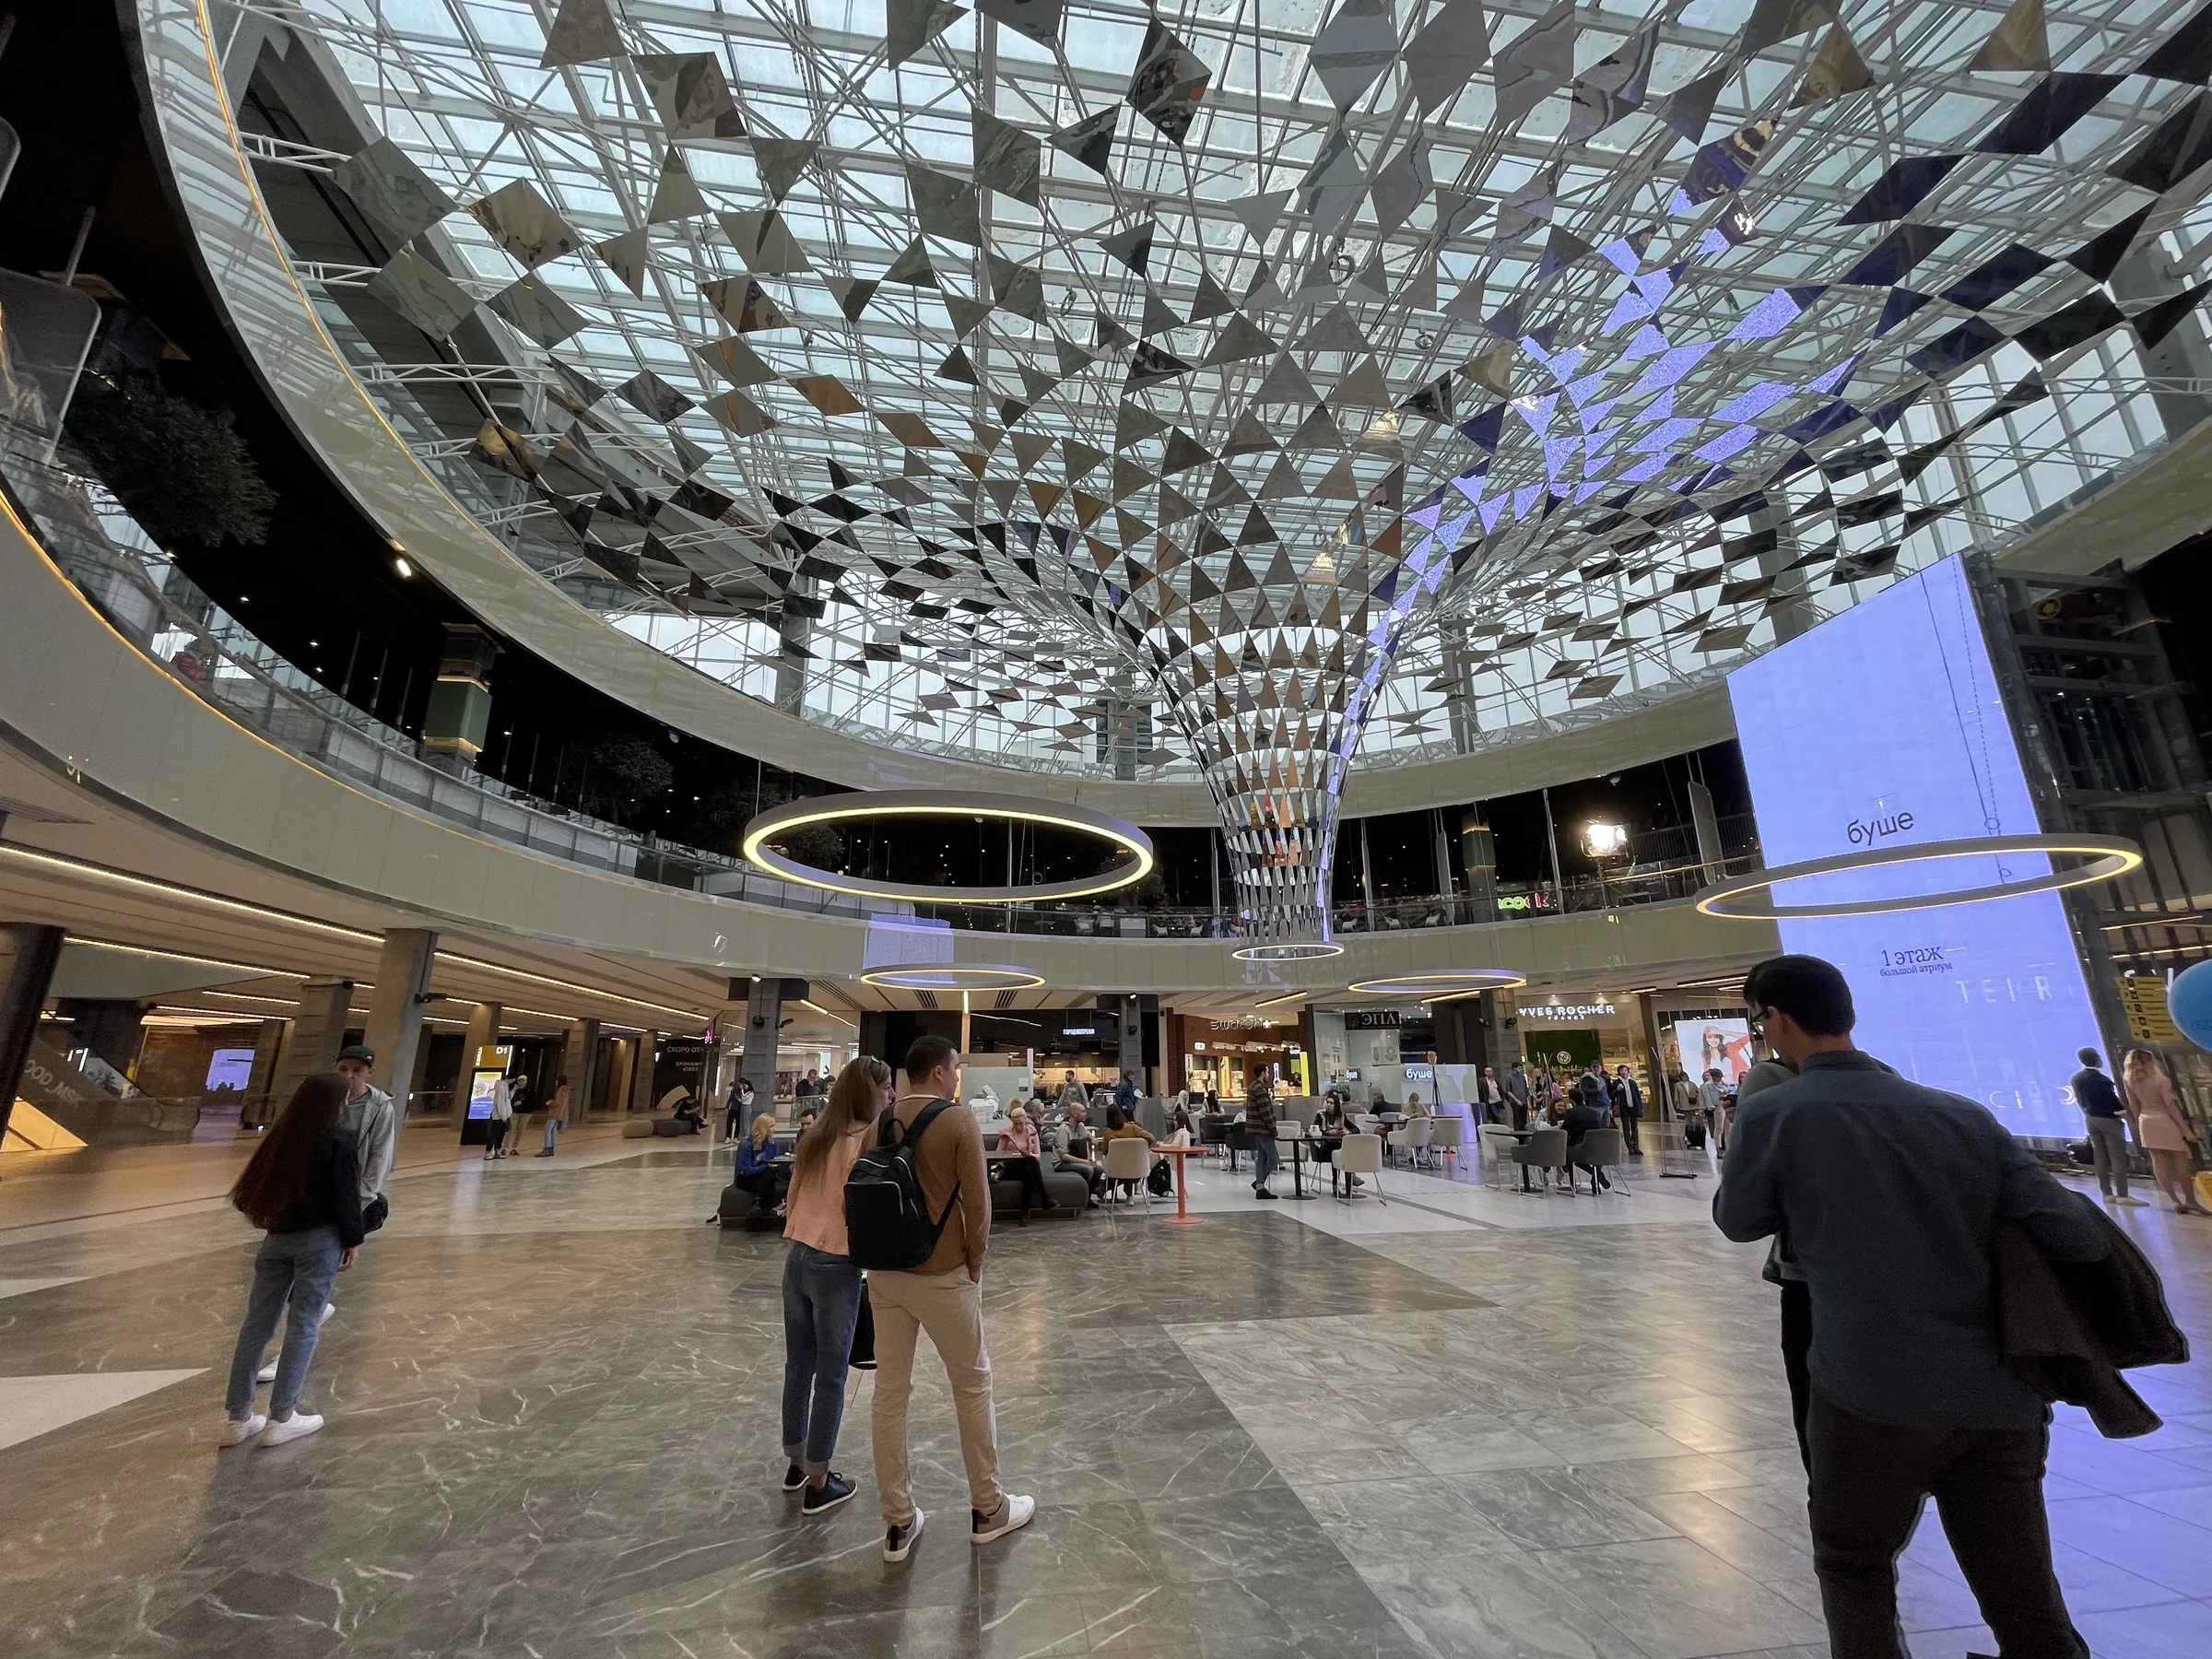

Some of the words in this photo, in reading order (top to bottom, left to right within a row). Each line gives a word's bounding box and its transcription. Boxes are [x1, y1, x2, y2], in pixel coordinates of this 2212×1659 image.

[1847, 812, 1913, 846] буше
[1880, 949, 1890, 966] 1
[1894, 947, 1944, 965] этаж
[1879, 965, 1918, 977] большой
[1919, 962, 1953, 974] атриум
[1517, 1007, 1553, 1018] YVES
[1557, 1005, 1616, 1015] ROCHER
[495, 1046, 508, 1054] D1
[1406, 1068, 1432, 1080] буше
